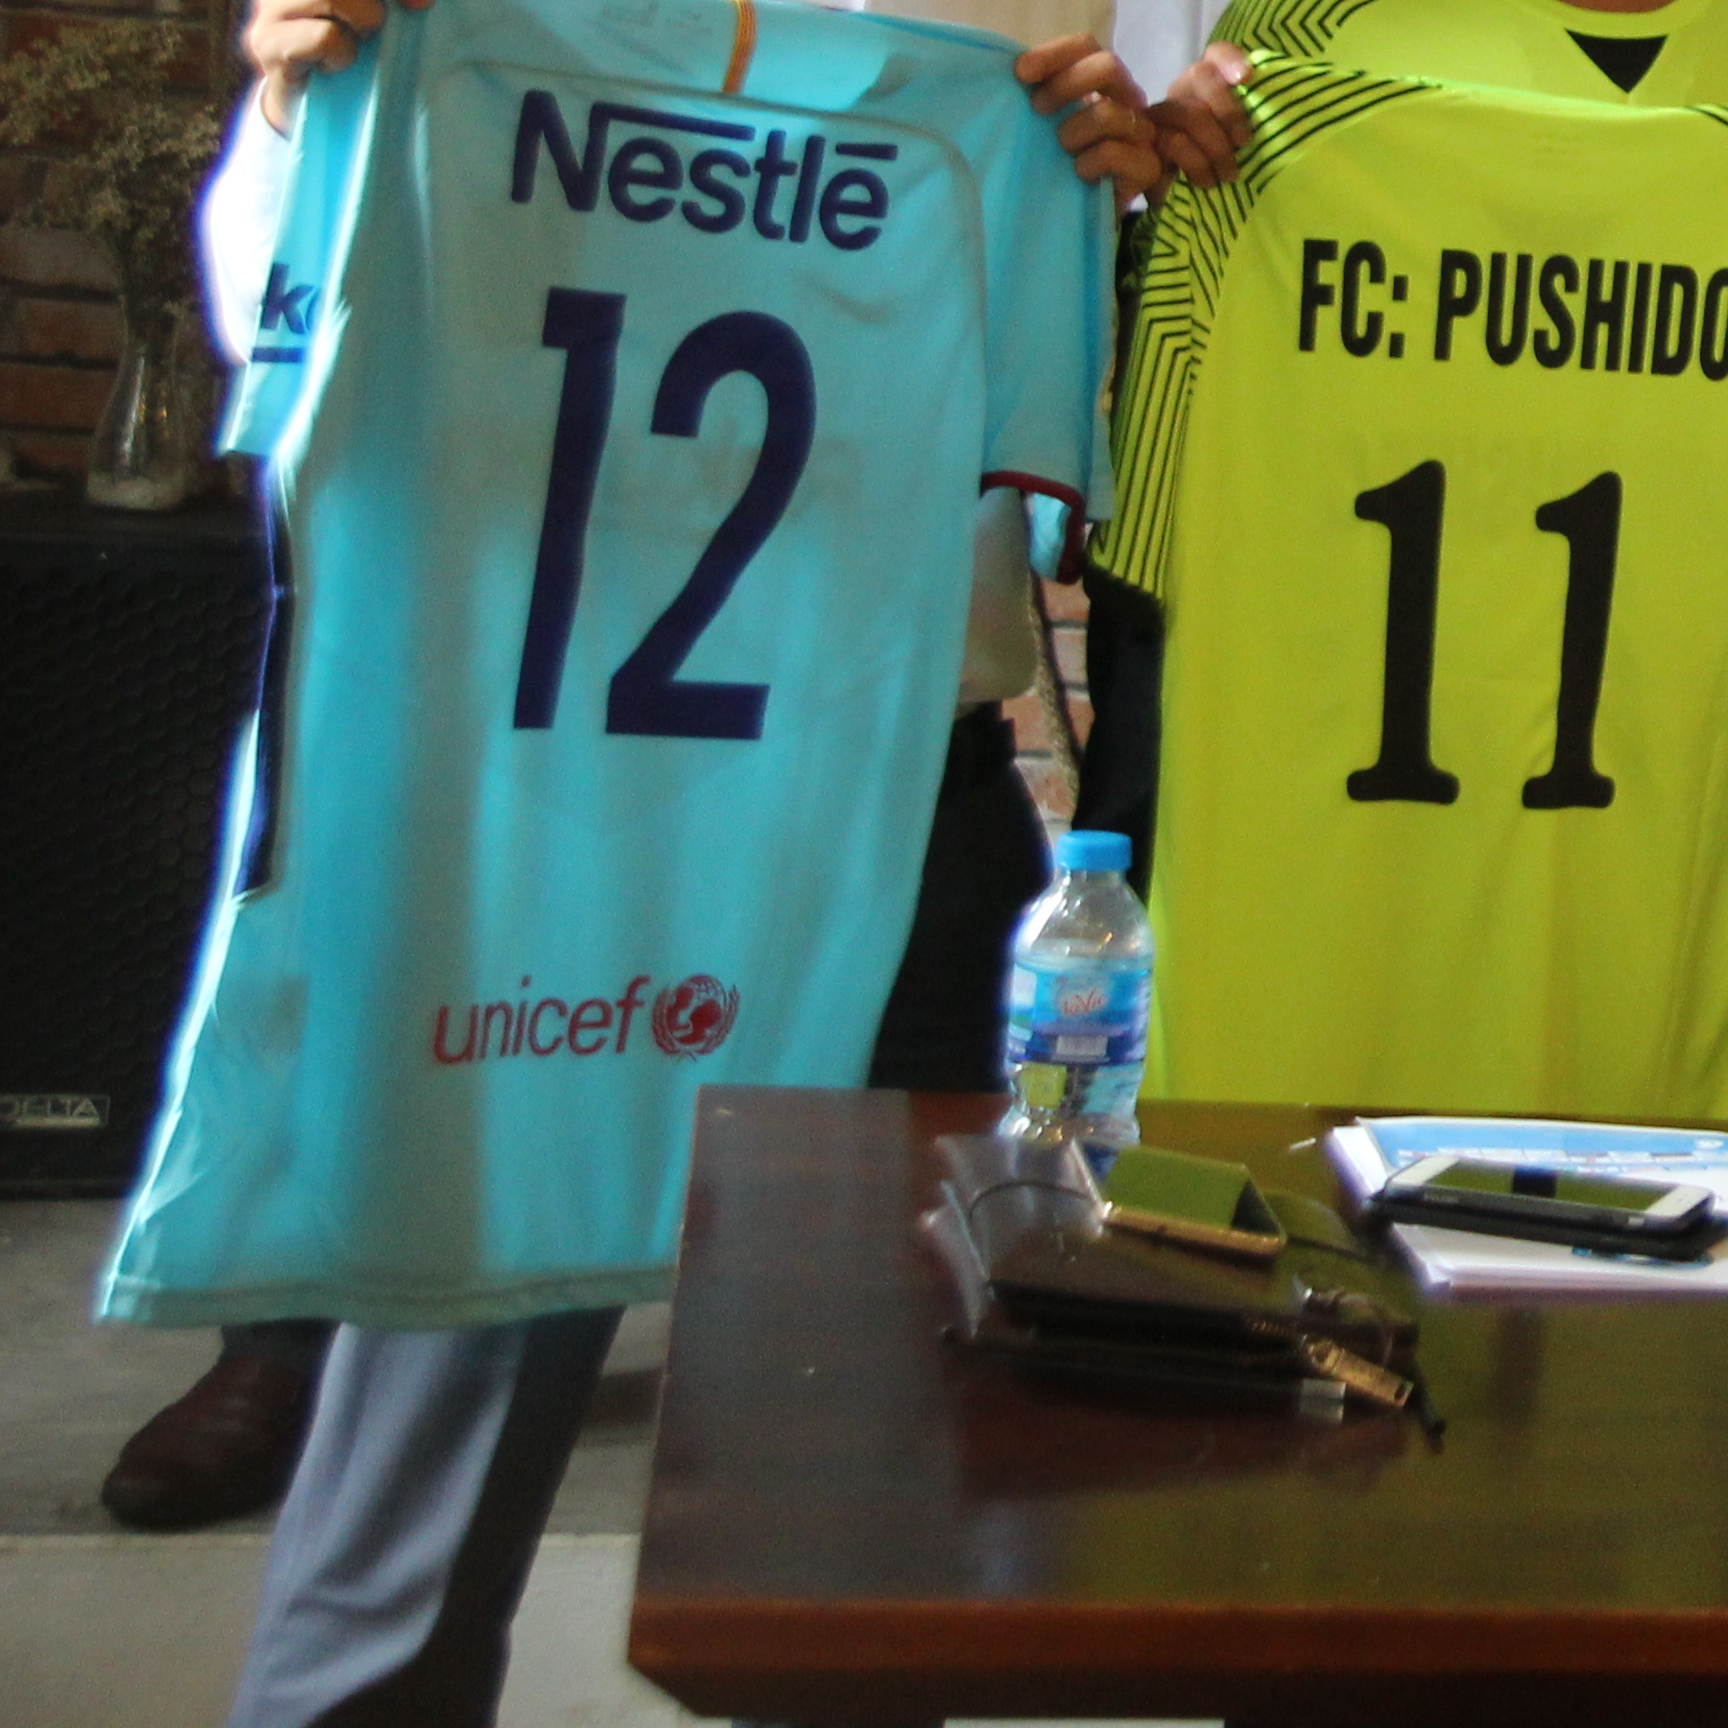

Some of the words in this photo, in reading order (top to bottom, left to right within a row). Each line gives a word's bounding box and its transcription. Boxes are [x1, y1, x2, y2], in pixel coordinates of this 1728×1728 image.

[1298, 239, 1409, 359] FC:
[513, 285, 818, 741] 12
[1346, 459, 1623, 809] 11
[433, 974, 651, 1064] unicef
